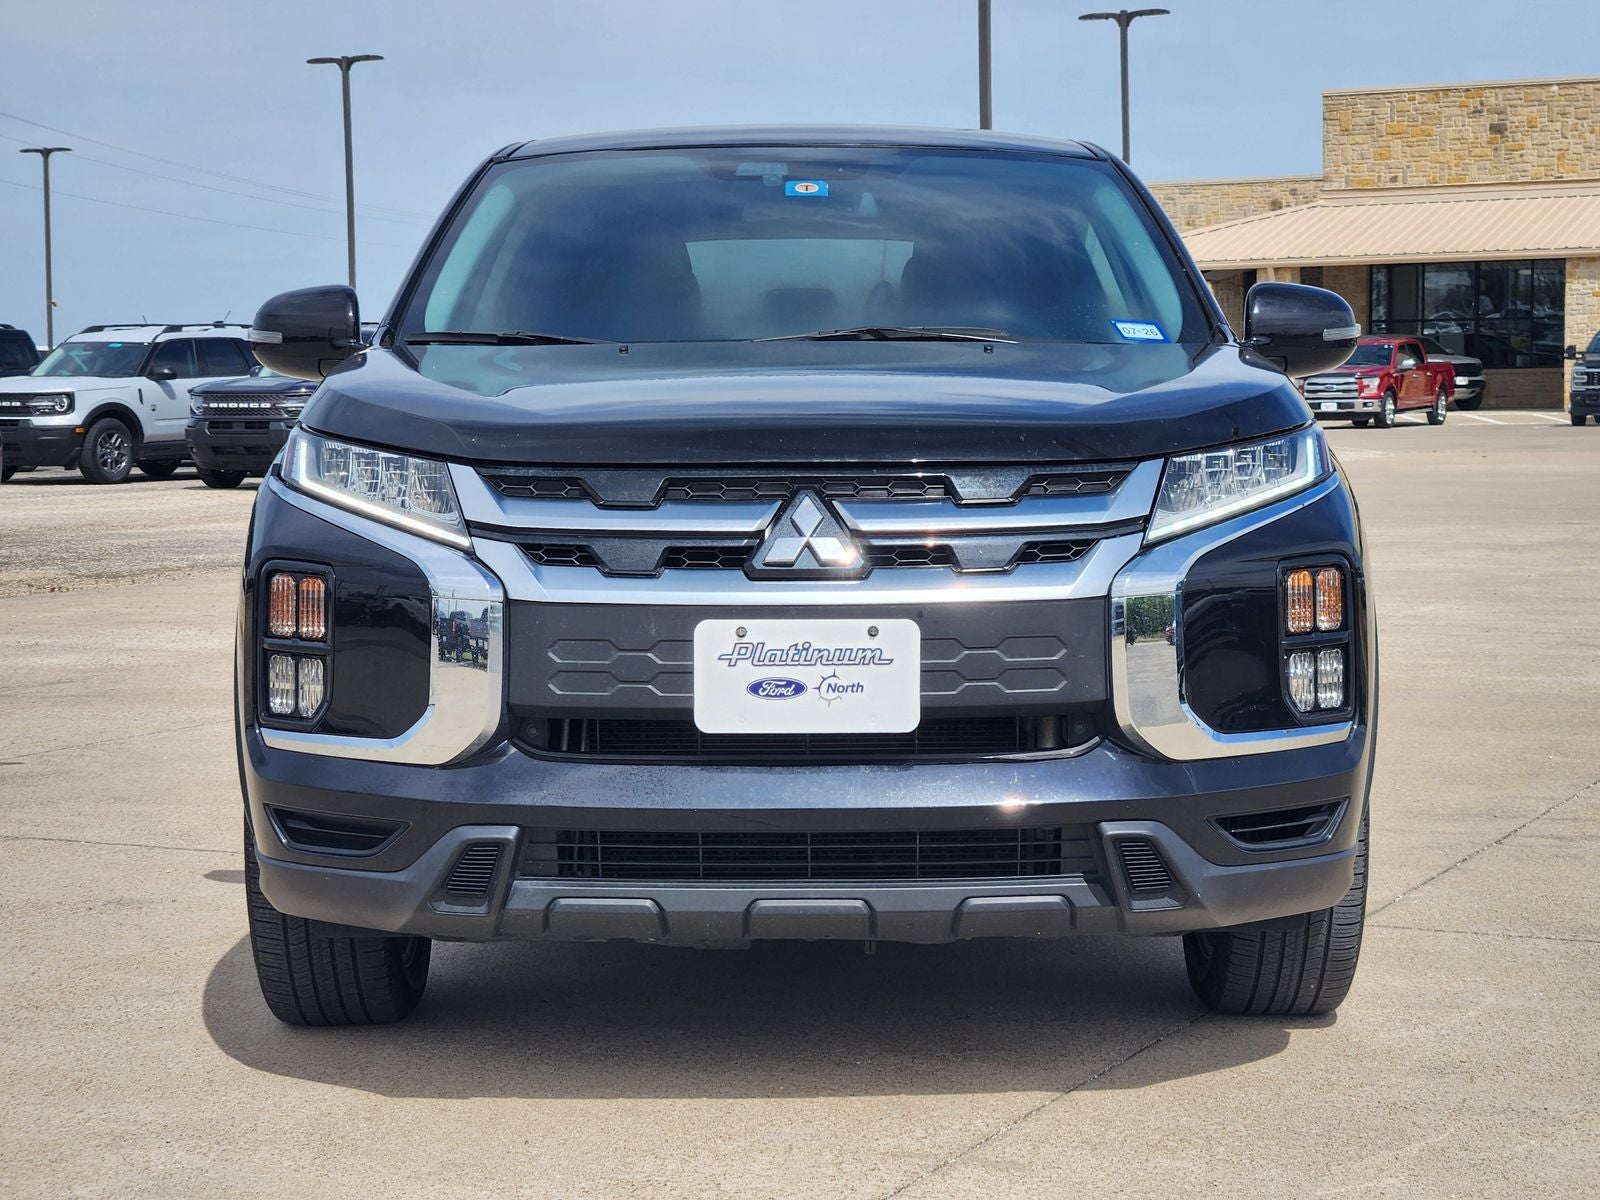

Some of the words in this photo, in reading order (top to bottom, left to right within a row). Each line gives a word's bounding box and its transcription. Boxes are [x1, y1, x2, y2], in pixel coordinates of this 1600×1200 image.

[1122, 326, 1158, 336] 07-26
[718, 641, 893, 666] Platinum
[758, 680, 796, 696] Ford
[826, 681, 864, 694] North
